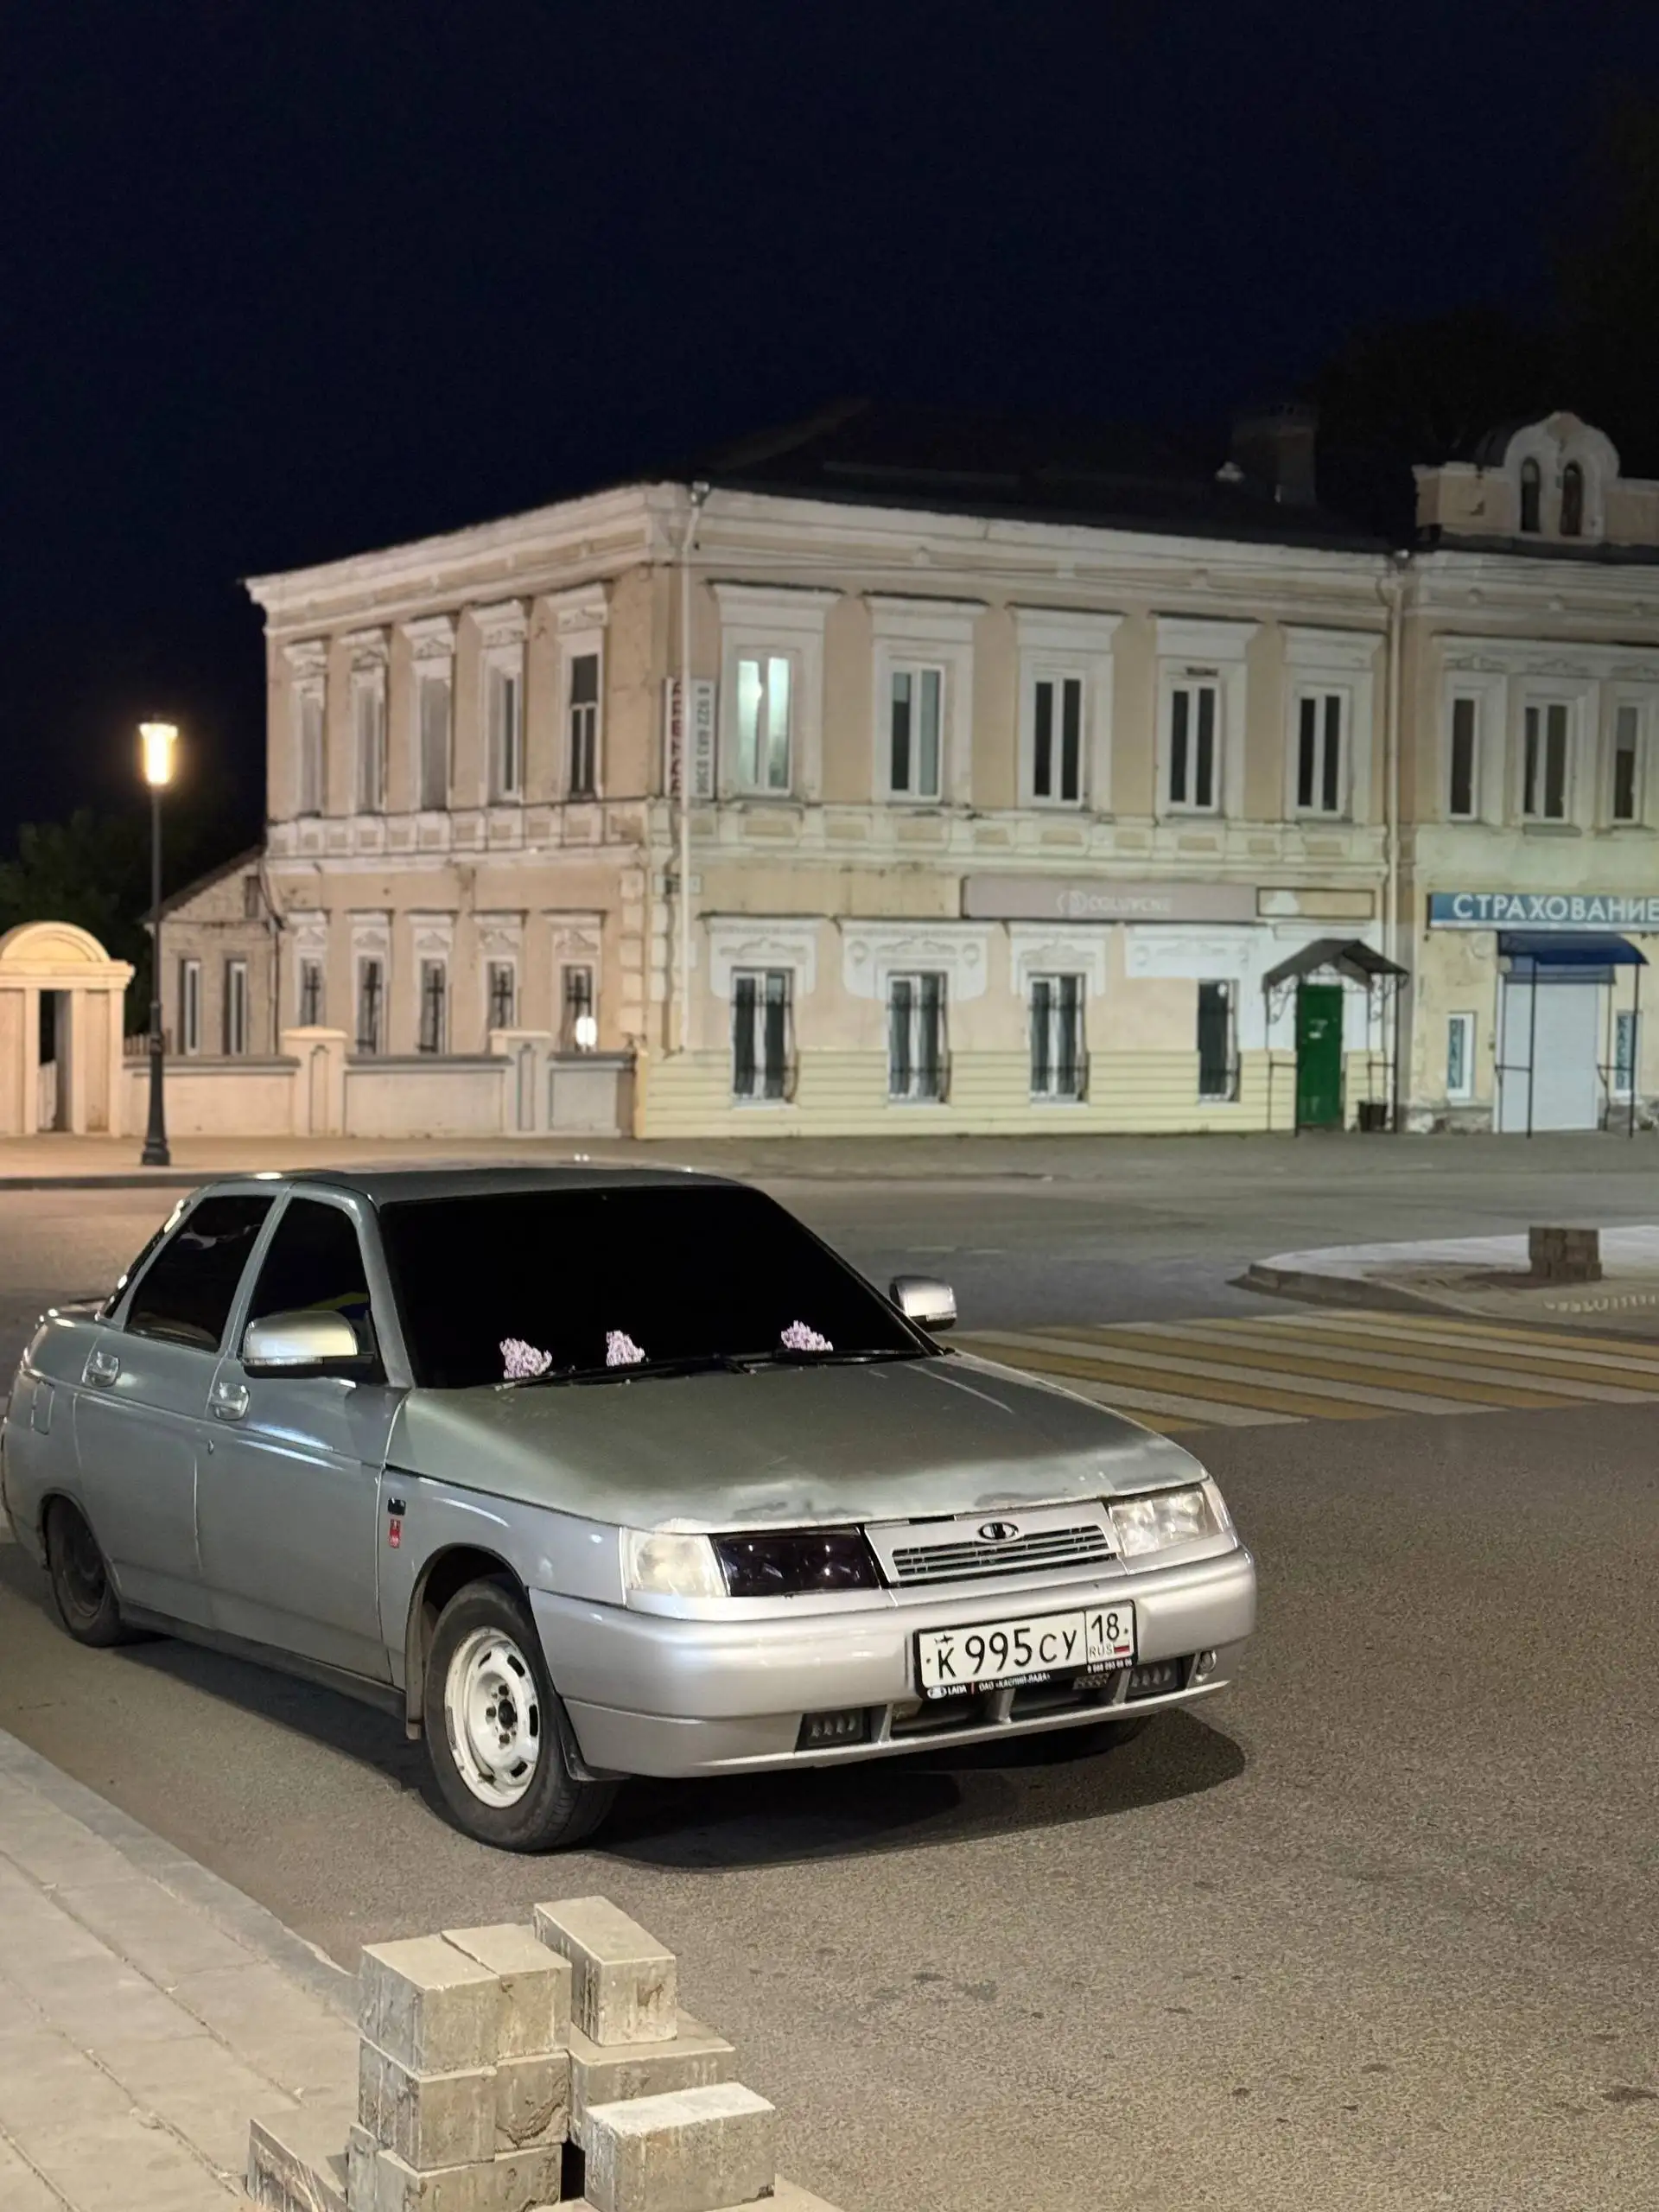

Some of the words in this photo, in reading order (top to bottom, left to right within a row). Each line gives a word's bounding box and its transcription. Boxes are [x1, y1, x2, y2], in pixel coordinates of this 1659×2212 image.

[1452, 893, 1659, 922] СТРАХОВАНИЕ
[1091, 1612, 1120, 1643] 18
[1089, 1643, 1113, 1657] RUS
[948, 1684, 967, 1695] LADA
